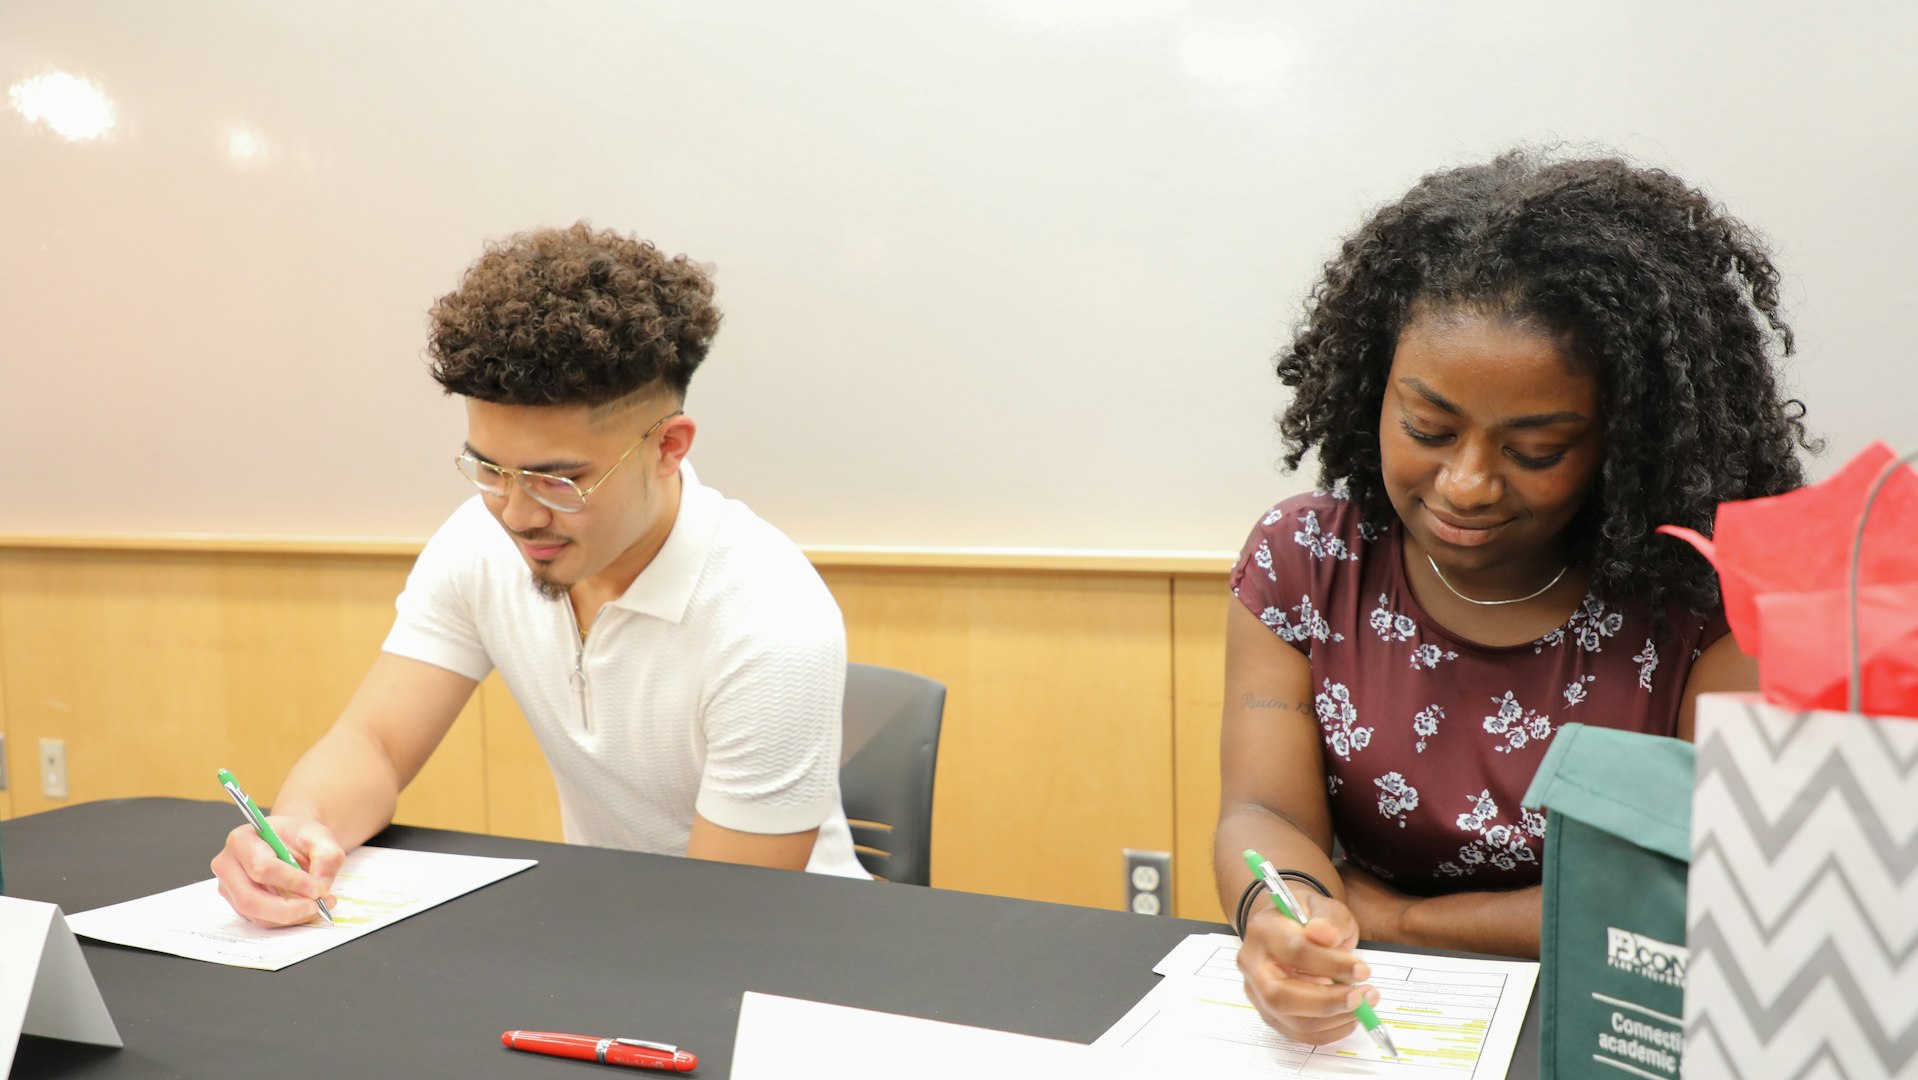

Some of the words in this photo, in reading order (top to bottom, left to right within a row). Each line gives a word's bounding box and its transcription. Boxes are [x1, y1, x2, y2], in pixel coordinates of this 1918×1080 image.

[1240, 692, 1290, 710] Psalm
[1295, 701, 1312, 715] 13
[1598, 1033, 1676, 1073] academic
